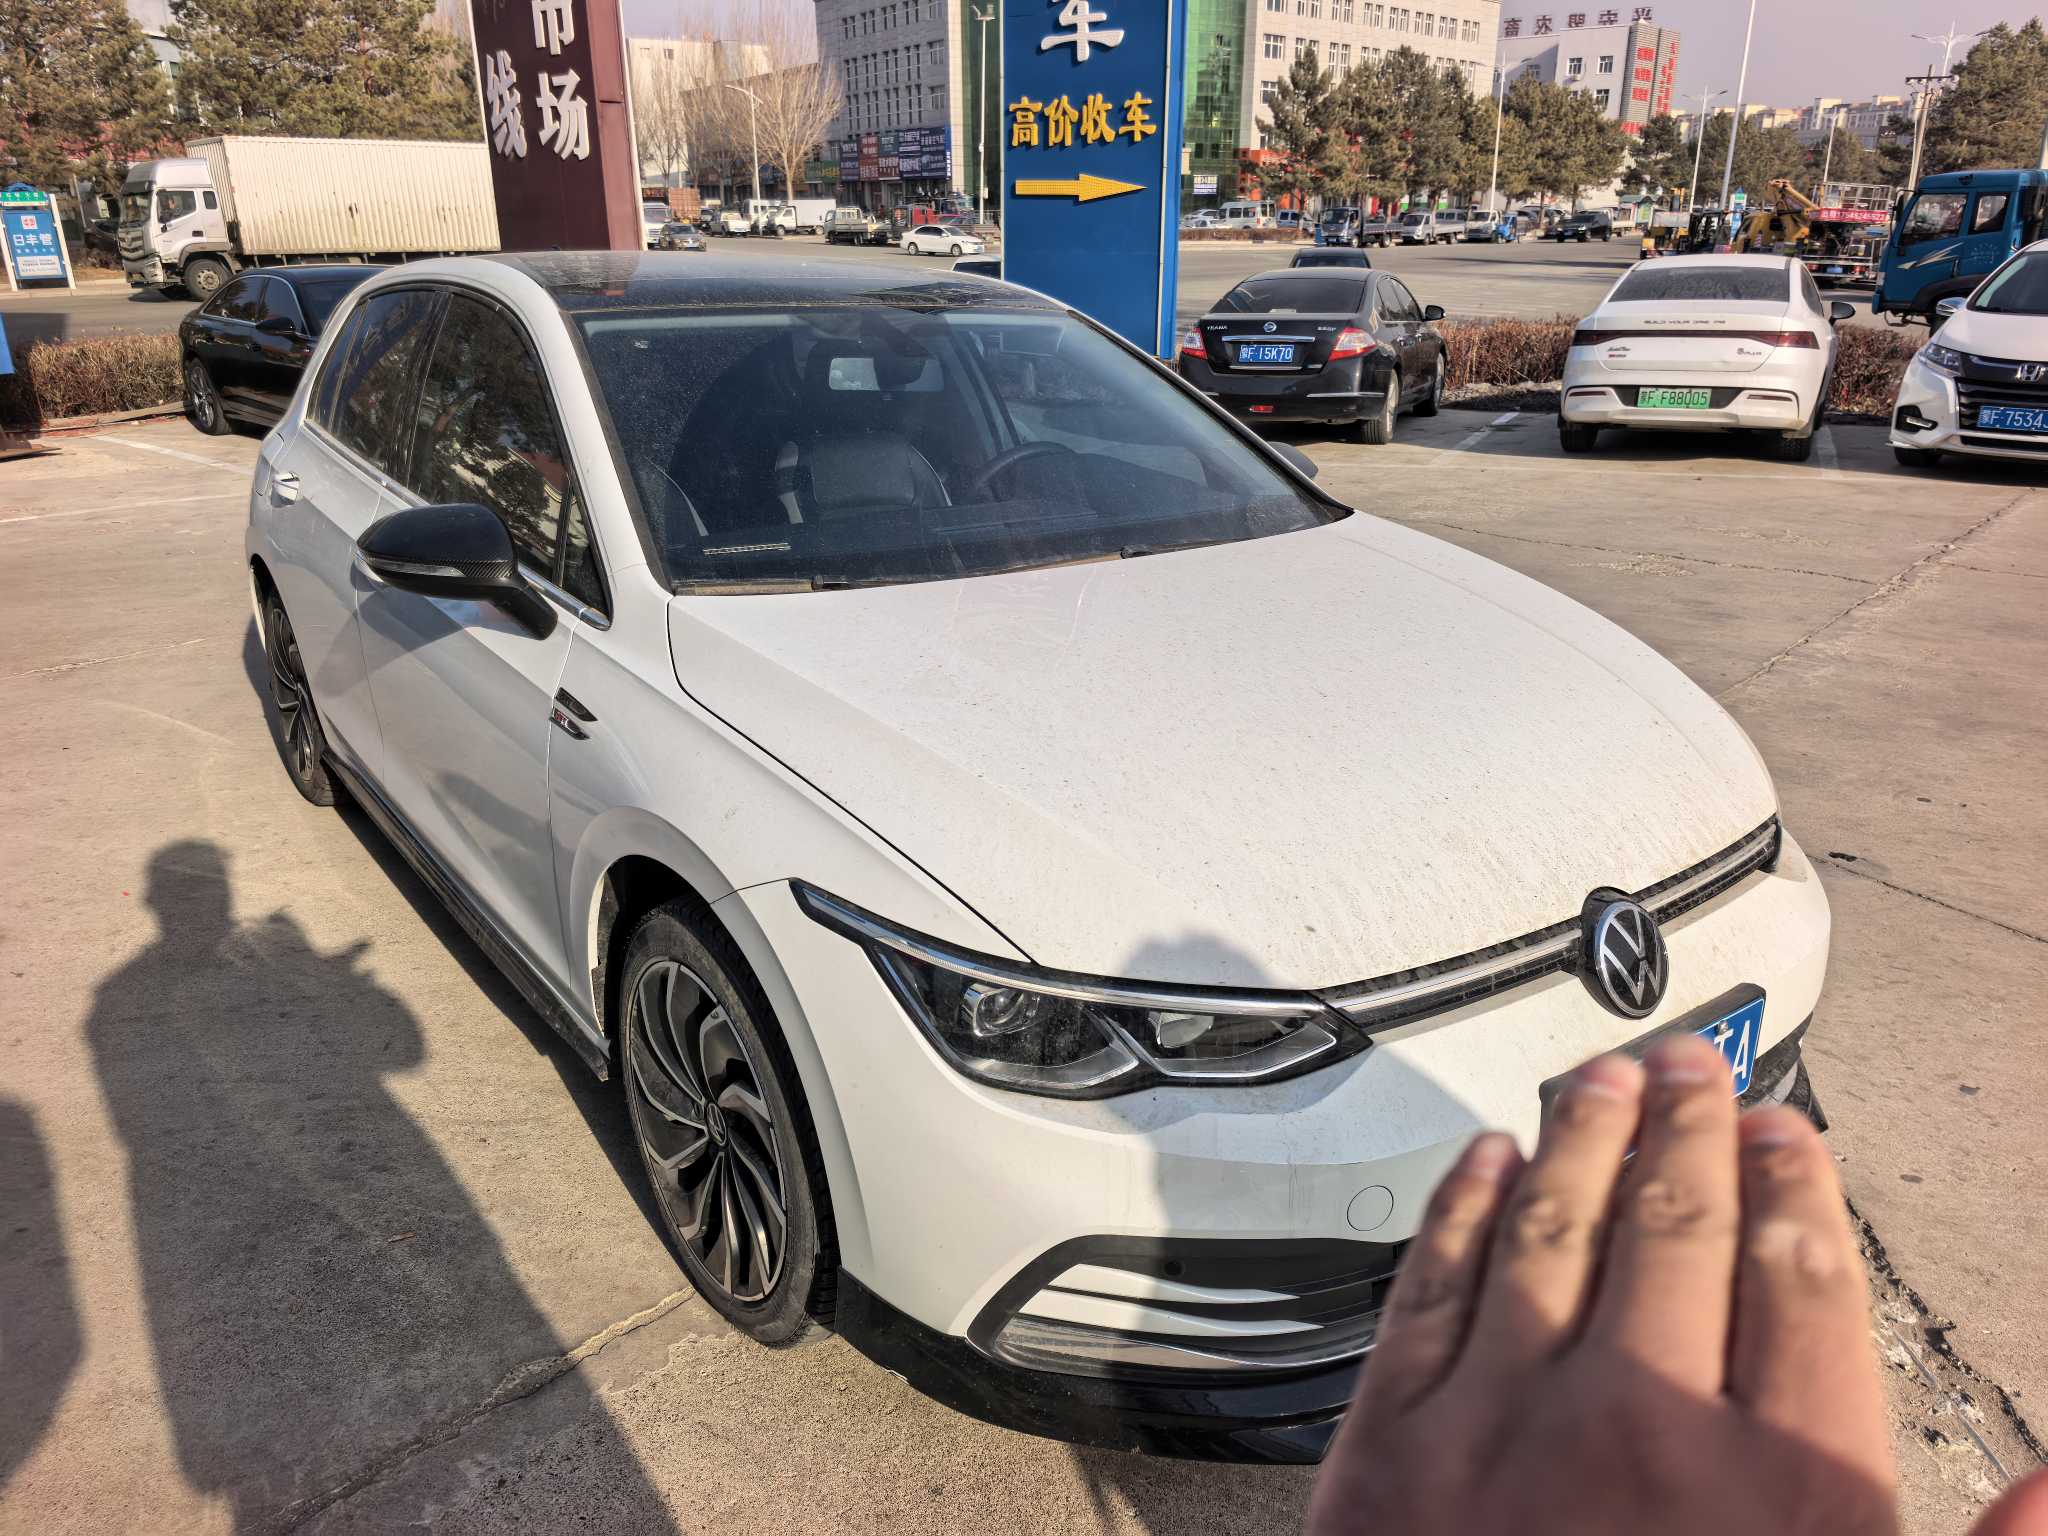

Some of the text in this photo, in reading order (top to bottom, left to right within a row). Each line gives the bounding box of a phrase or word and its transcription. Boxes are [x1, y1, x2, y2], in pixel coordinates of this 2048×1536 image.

[1041, 0, 1125, 62] 车
[1009, 91, 1157, 147] 高价收车
